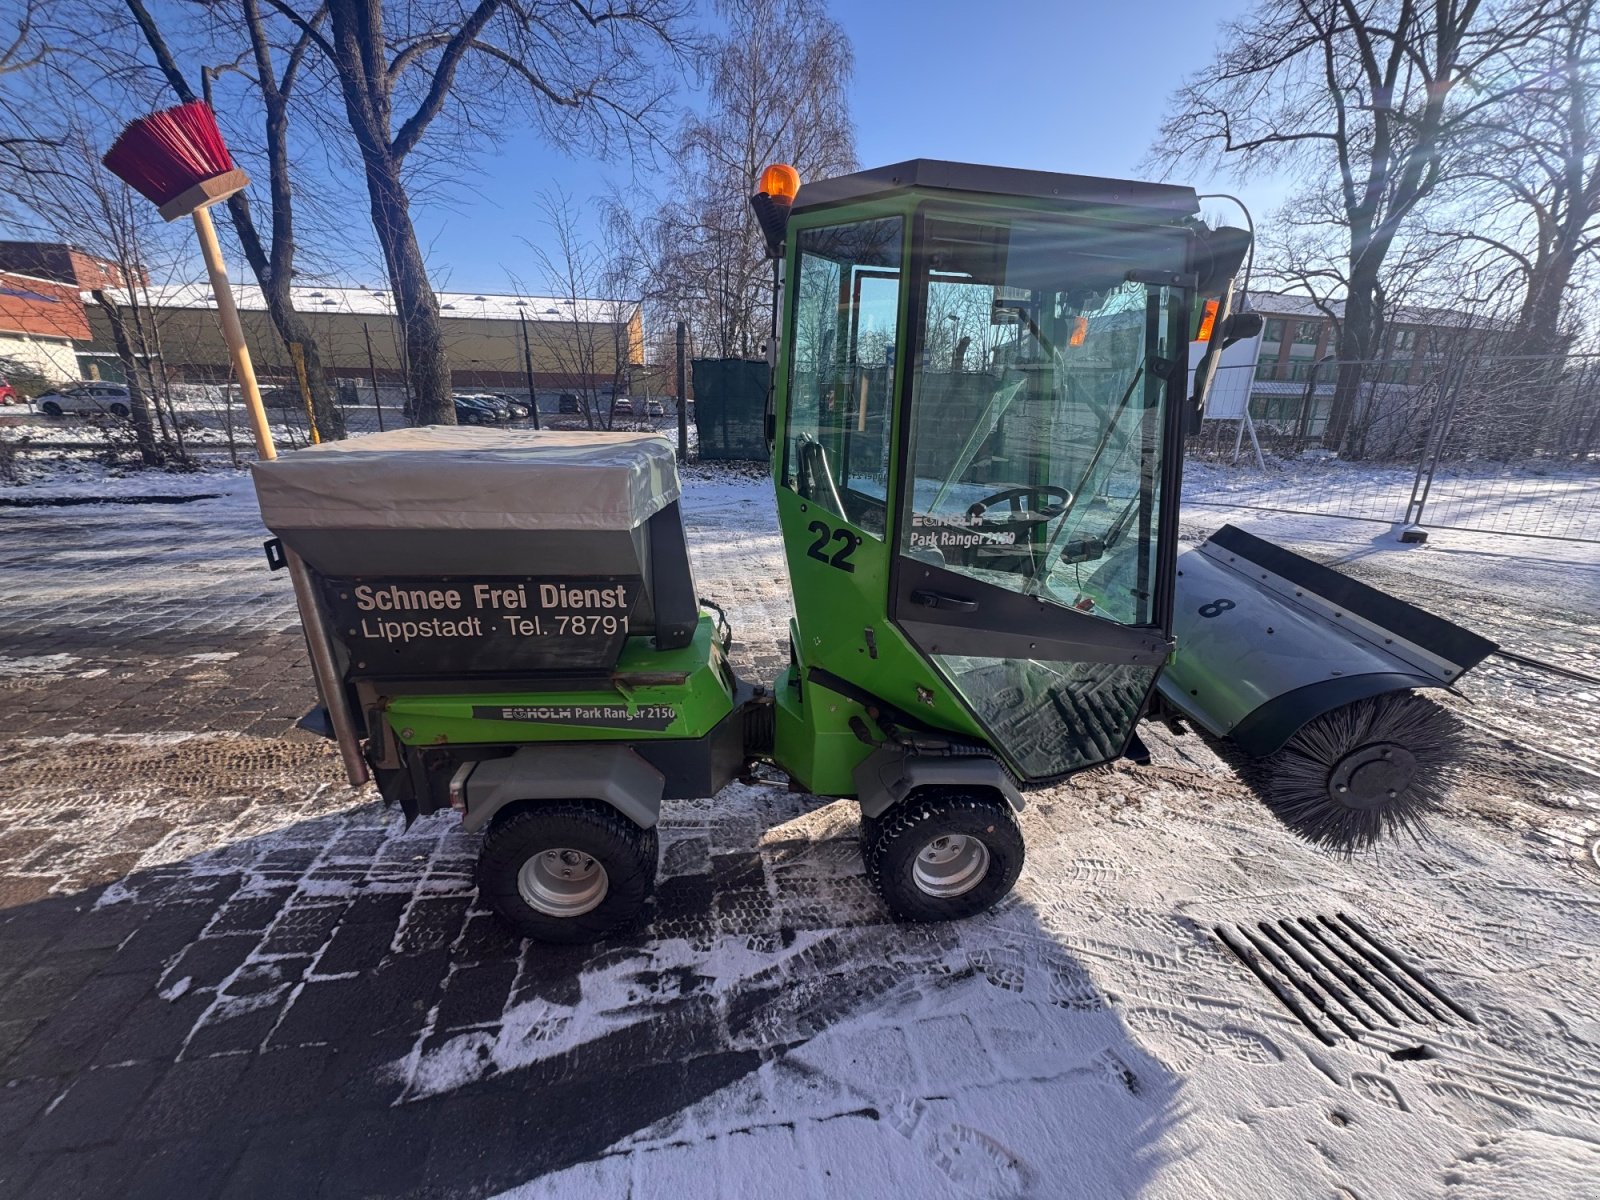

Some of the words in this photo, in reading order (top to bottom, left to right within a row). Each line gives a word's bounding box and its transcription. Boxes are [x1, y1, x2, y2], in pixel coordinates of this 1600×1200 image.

[807, 520, 857, 573] 22
[910, 531, 938, 546] Park
[941, 532, 984, 549] Ranger
[986, 531, 1015, 545] 2150
[355, 585, 462, 611] Schnee
[473, 584, 528, 609] Frei
[539, 584, 627, 609] Dienst
[1198, 598, 1236, 618] 8
[361, 616, 483, 643] Lippstadt
[503, 615, 548, 636] Tel.
[554, 615, 629, 635] 78791
[502, 707, 571, 719] EGHOLM
[575, 708, 602, 719] Park
[647, 708, 675, 719] 2150
